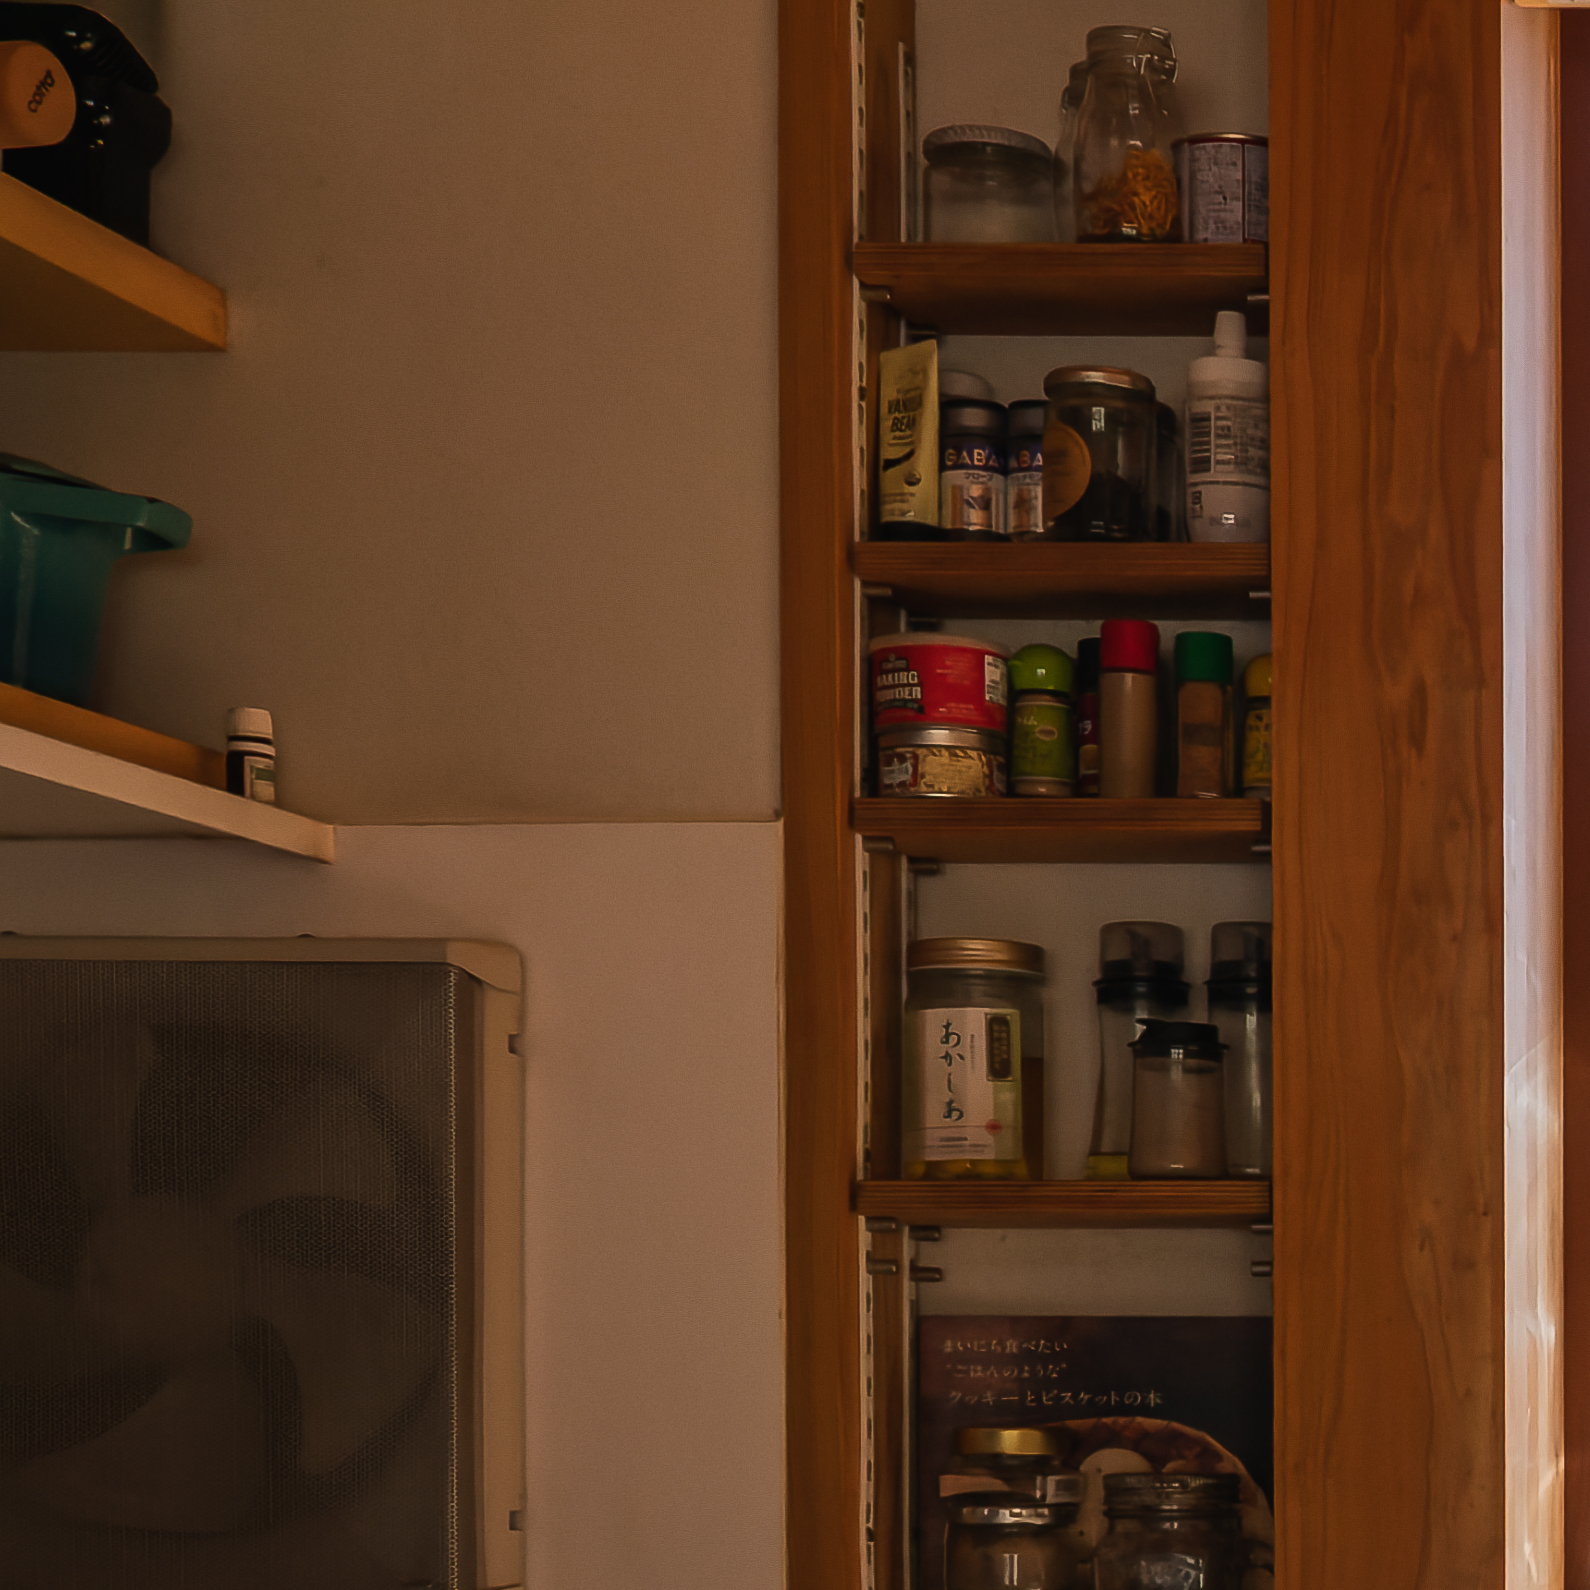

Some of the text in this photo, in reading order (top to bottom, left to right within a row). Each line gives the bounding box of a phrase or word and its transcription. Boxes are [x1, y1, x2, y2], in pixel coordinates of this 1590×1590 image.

[945, 448, 1000, 468] GABA
[877, 686, 922, 702] DER
[939, 1019, 966, 1122] あかしあ
[950, 1389, 1163, 1408] クッキーとビスケットの本
